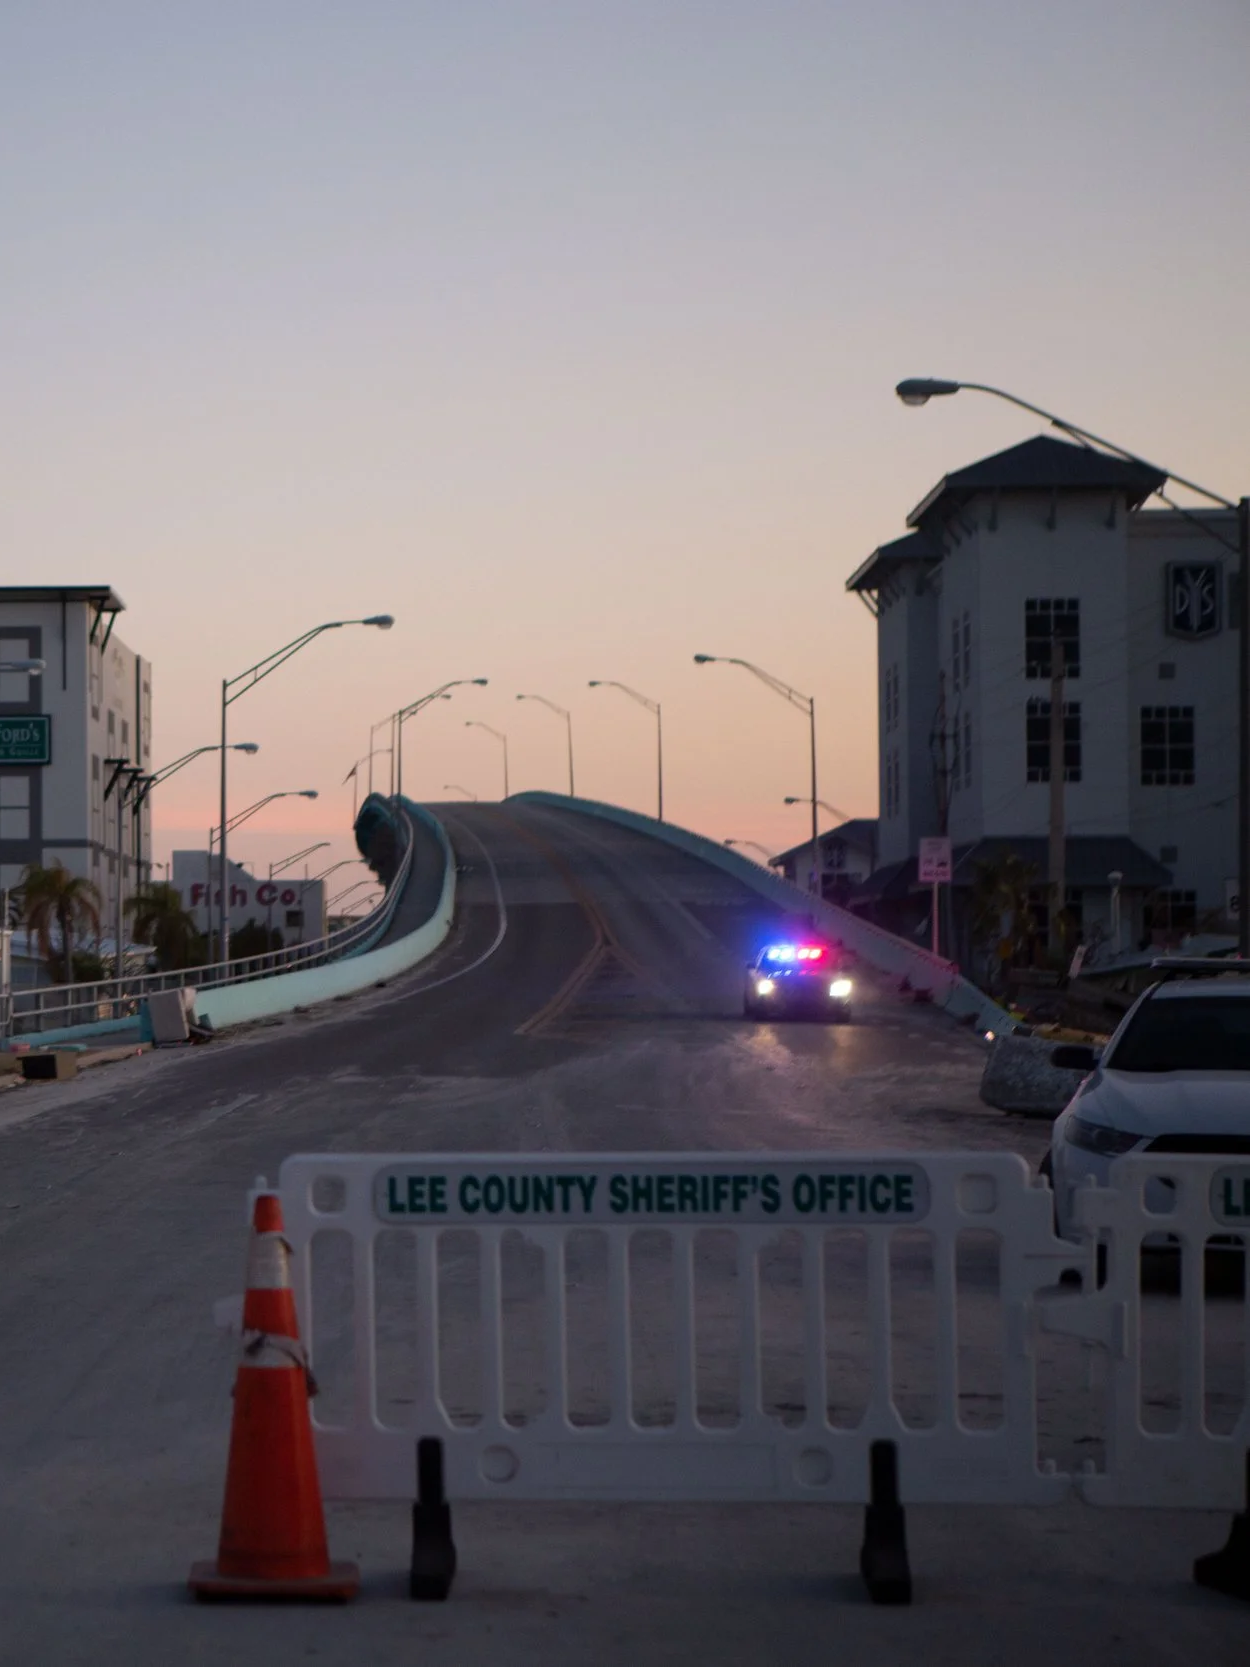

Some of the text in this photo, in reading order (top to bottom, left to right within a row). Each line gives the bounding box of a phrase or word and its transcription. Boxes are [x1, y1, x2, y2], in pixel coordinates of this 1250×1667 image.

[256, 883, 302, 907] Co.
[388, 1174, 915, 1214] LEE COUNTY SHERIFF'S OFFICE
